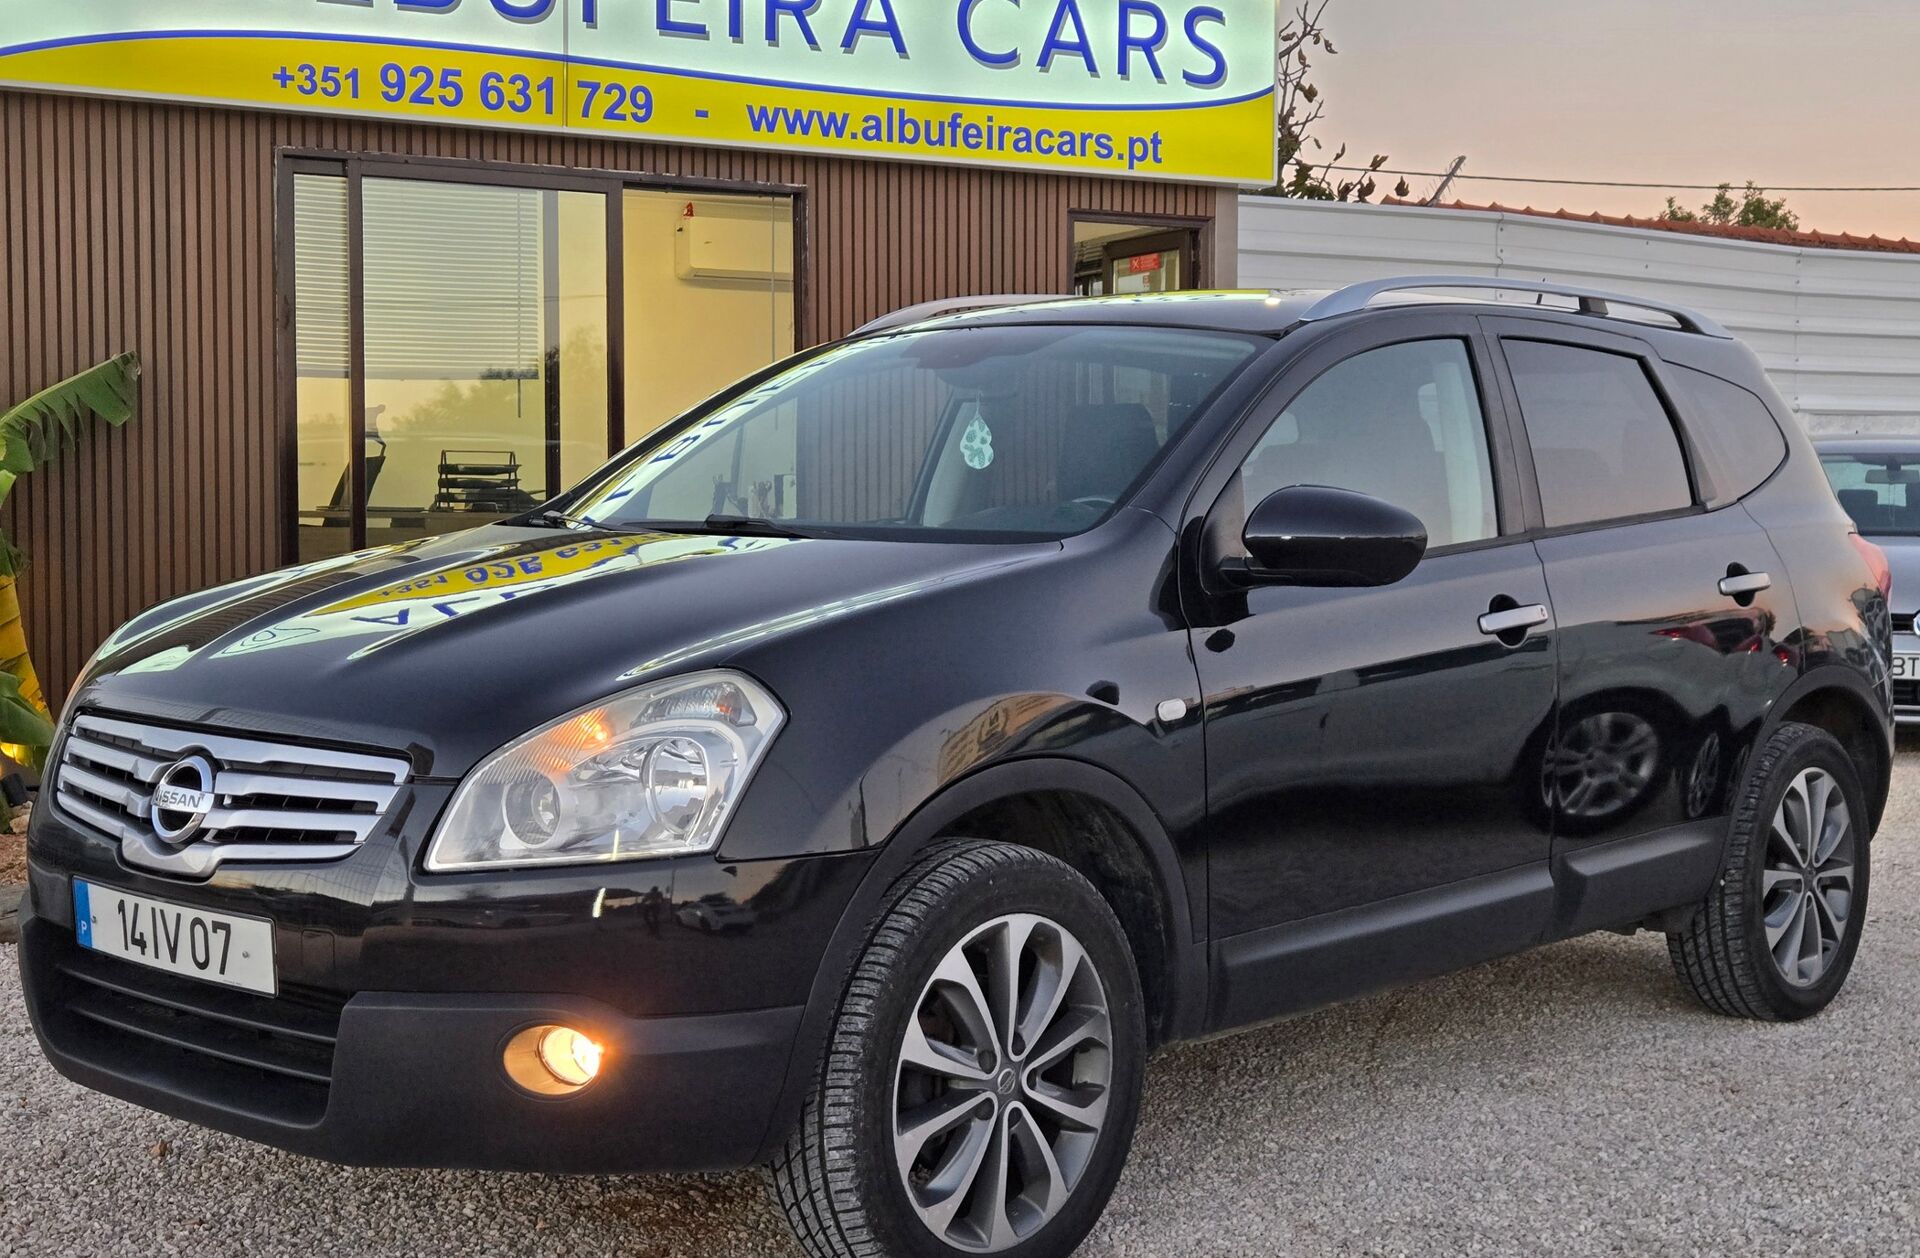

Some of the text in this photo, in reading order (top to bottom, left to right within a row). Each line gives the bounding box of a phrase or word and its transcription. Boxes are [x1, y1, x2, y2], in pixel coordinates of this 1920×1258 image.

[957, 0, 1228, 89] CARS
[273, 64, 361, 99] +351
[380, 63, 463, 107] 925
[479, 72, 555, 115] 631
[577, 80, 654, 123] 729
[747, 104, 1163, 171] www.albufeiracars.pt
[80, 920, 88, 934] P
